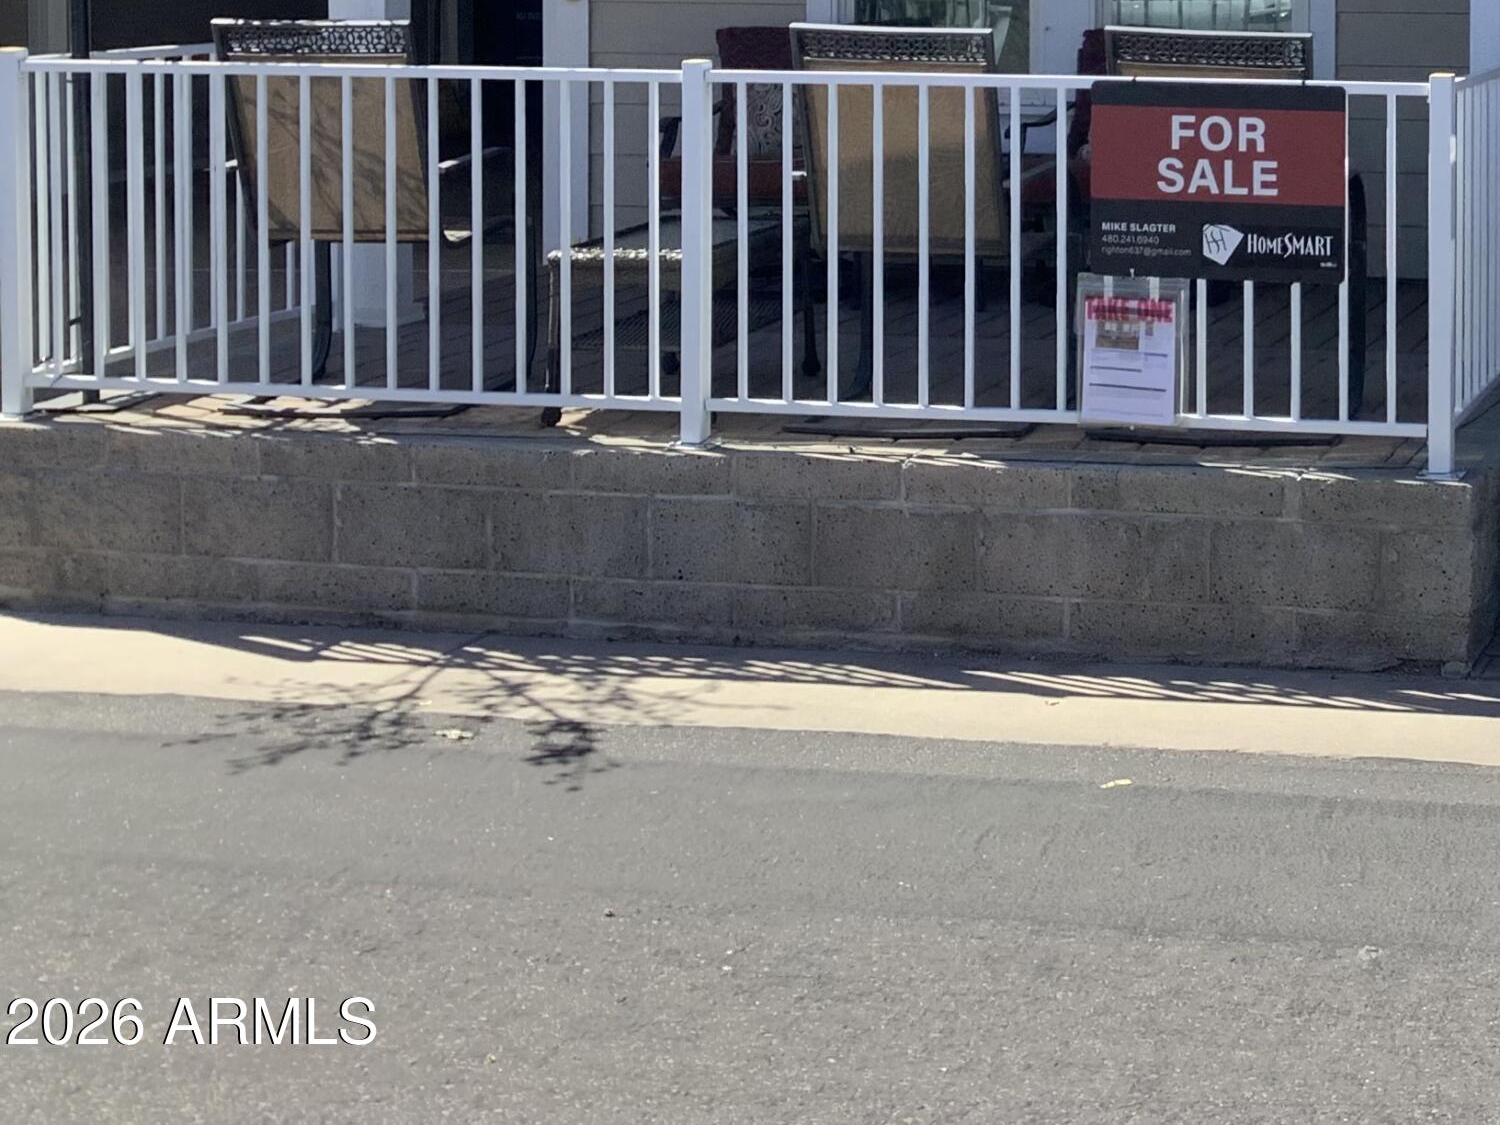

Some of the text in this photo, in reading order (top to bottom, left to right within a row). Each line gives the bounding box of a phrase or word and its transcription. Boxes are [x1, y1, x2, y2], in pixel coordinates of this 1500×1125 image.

[1170, 114, 1266, 153] FOR
[1156, 157, 1279, 196] SALE
[1101, 221, 1176, 233] MIKE SLAGTER
